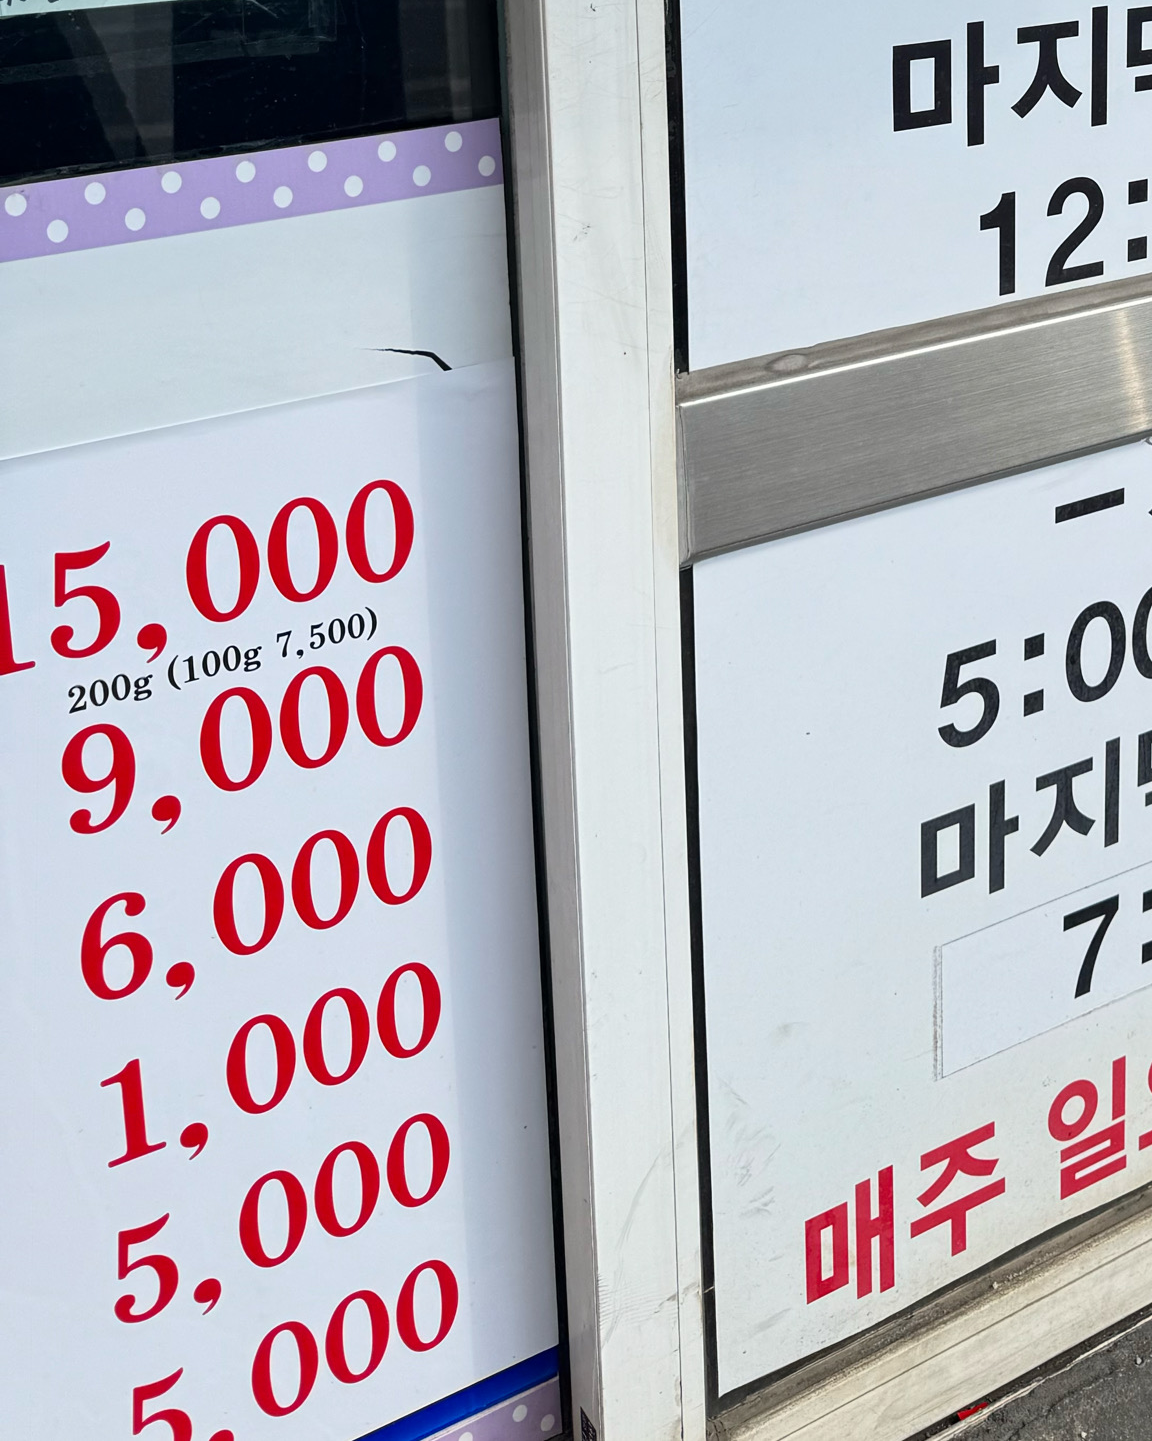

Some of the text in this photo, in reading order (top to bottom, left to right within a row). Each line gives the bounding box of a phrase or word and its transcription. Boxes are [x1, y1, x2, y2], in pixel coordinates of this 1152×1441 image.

[61, 645, 423, 835] 9,000
[68, 607, 378, 714] 200g (100g 7,500)
[80, 807, 432, 1000] 6,000
[100, 962, 441, 1168] 1,000
[114, 1113, 450, 1323] 5,000
[805, 1122, 1005, 1304] 매주
